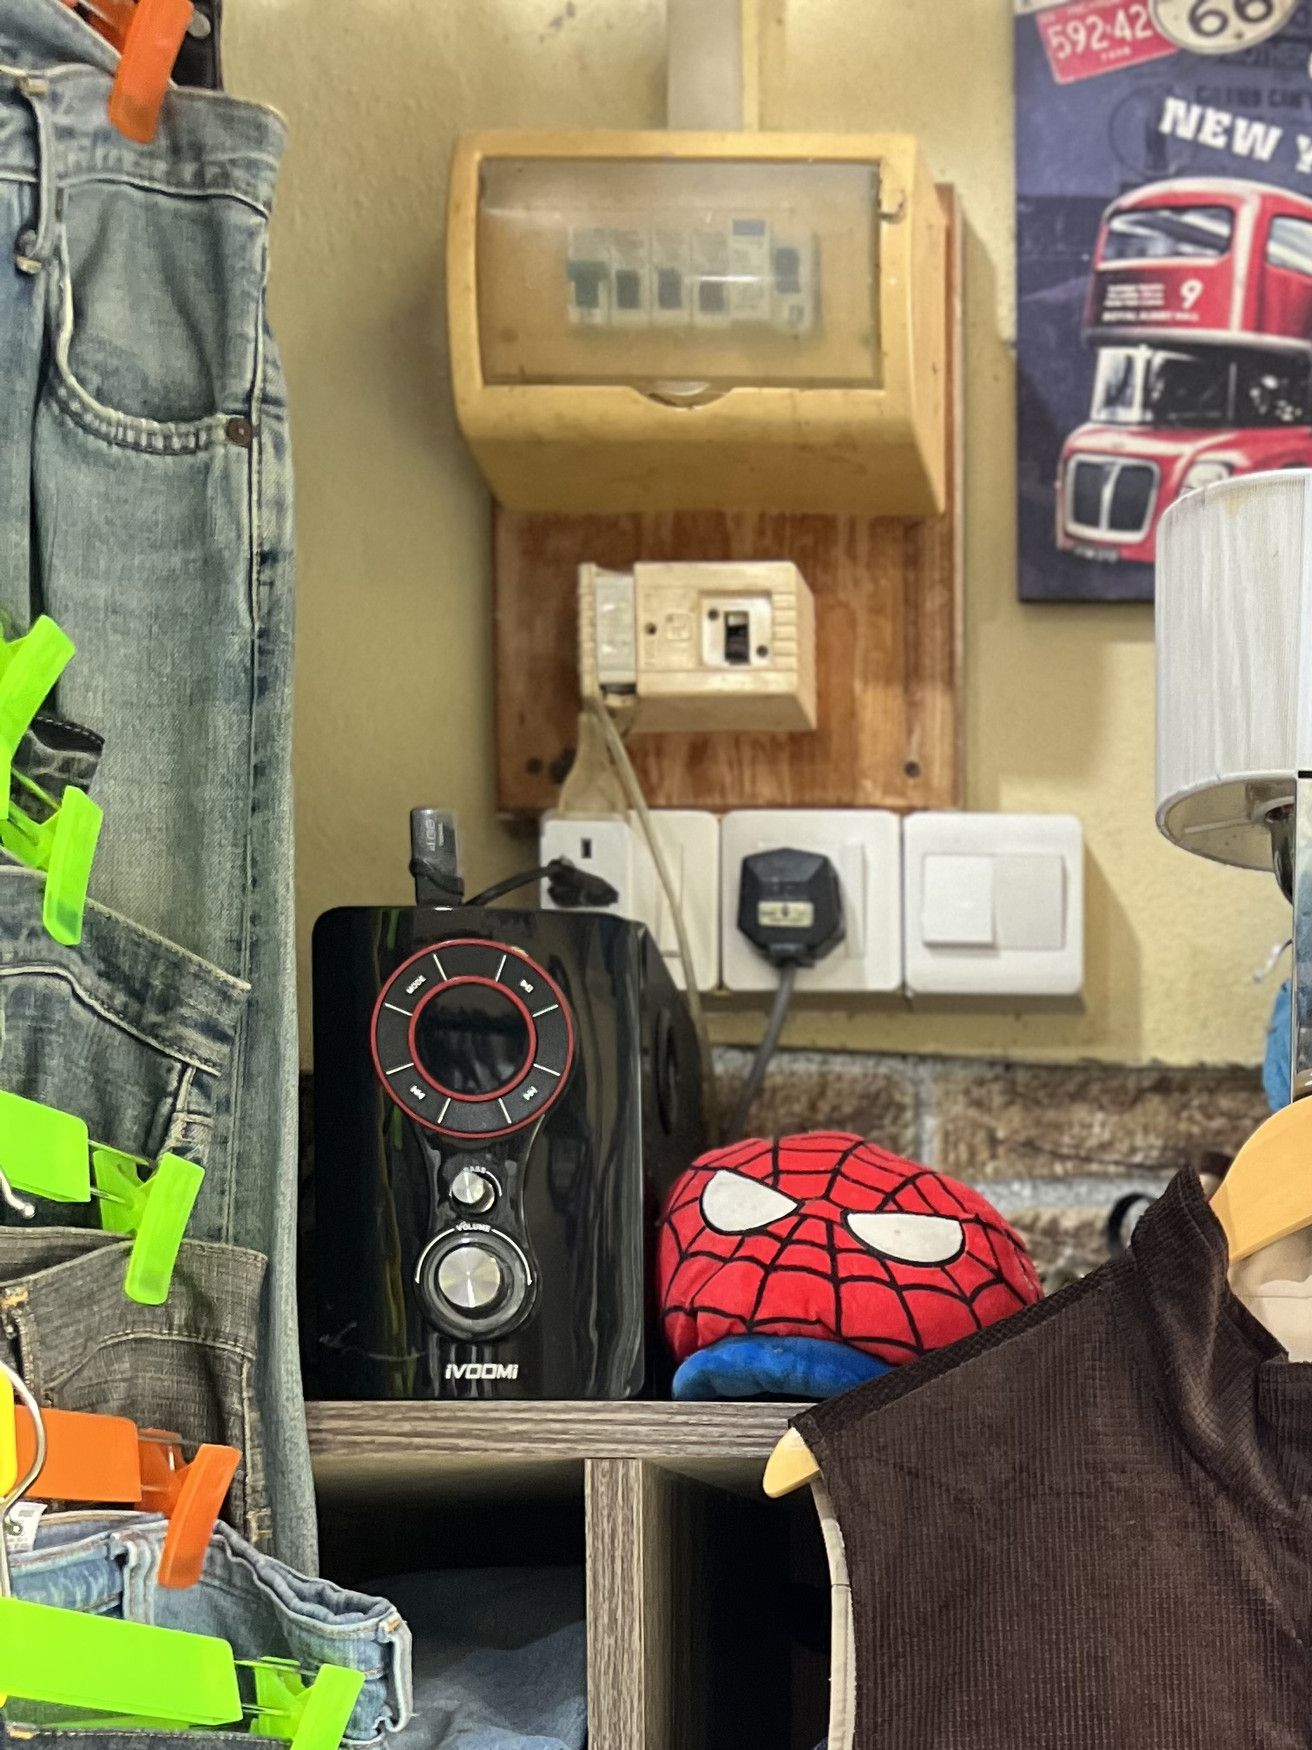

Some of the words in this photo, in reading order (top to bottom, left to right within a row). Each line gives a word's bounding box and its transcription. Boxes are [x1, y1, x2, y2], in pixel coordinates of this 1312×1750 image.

[1159, 97, 1283, 163] NEW
[1180, 279, 1204, 310] 9
[406, 975, 427, 995] MODE
[455, 1223, 492, 1232] VOLUME
